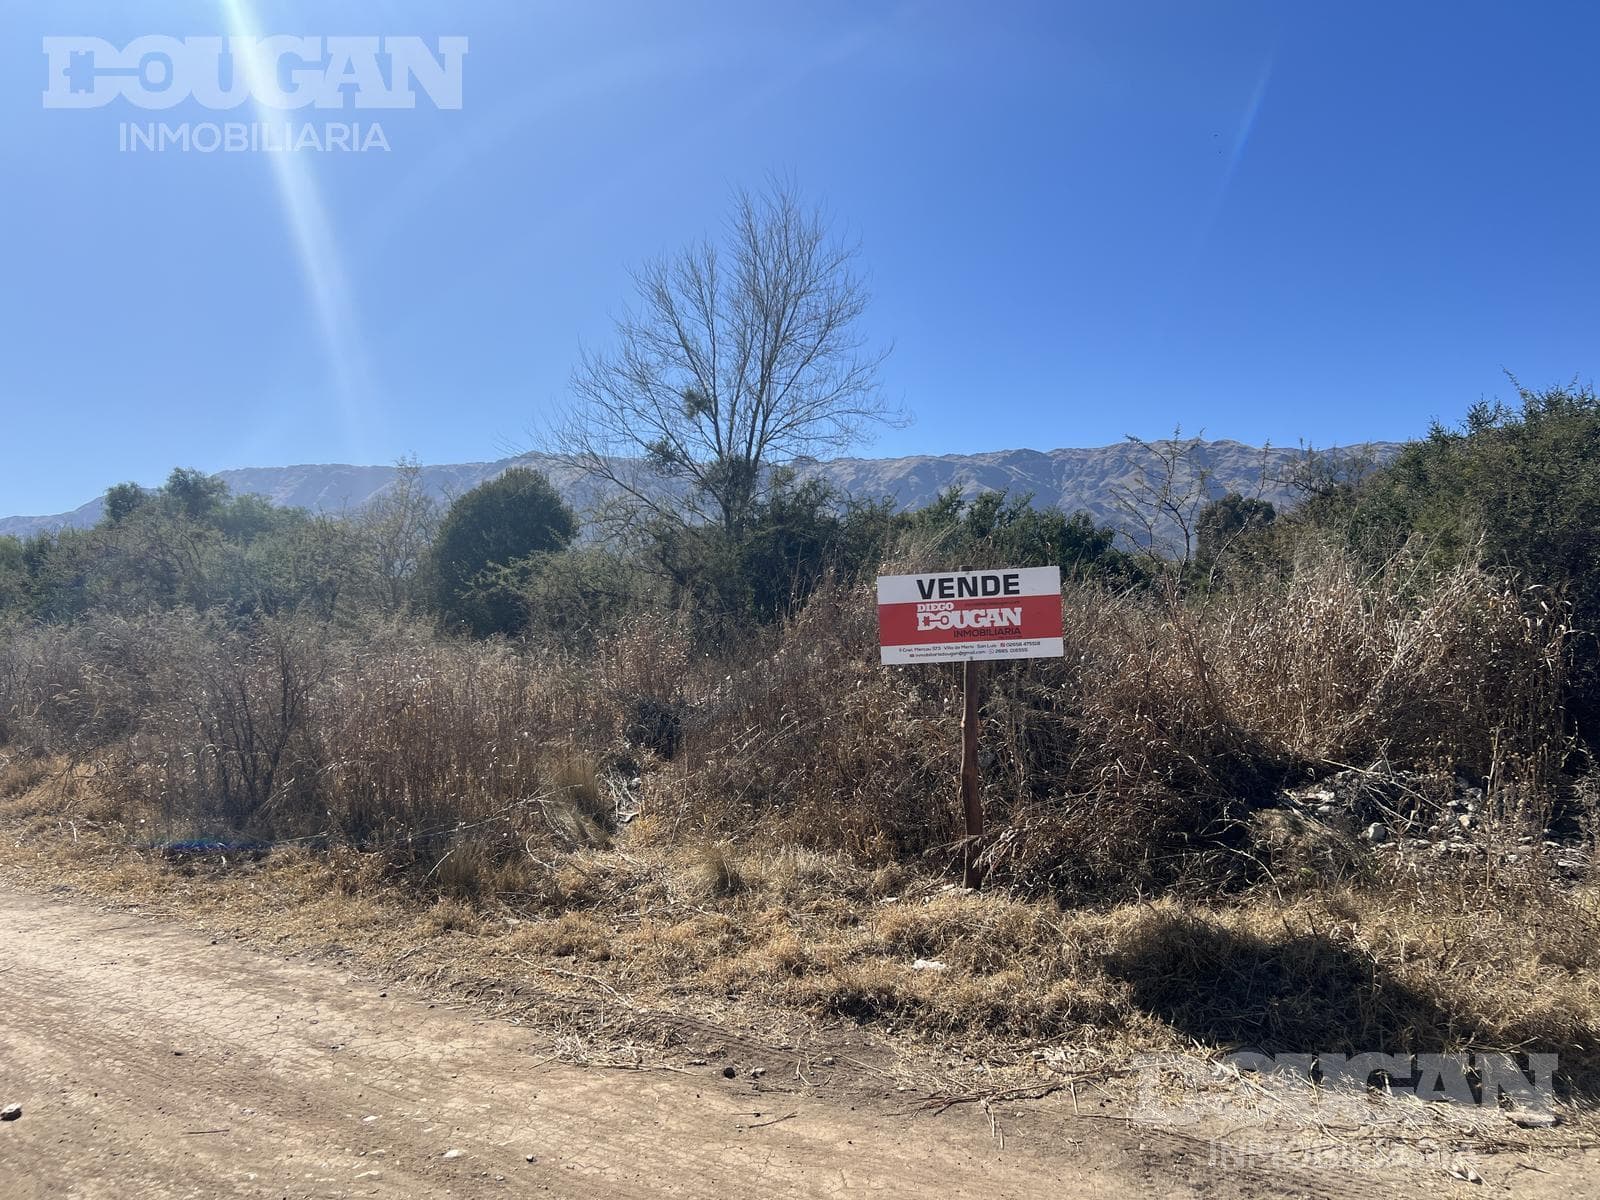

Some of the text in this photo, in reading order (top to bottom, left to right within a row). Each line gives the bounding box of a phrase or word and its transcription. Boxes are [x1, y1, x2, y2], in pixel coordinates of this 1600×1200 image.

[916, 573, 1020, 600] VENDE
[916, 602, 955, 613] DIEGO
[916, 607, 1023, 632] DOUGAN
[953, 628, 1022, 638] INMOBILIARIA
